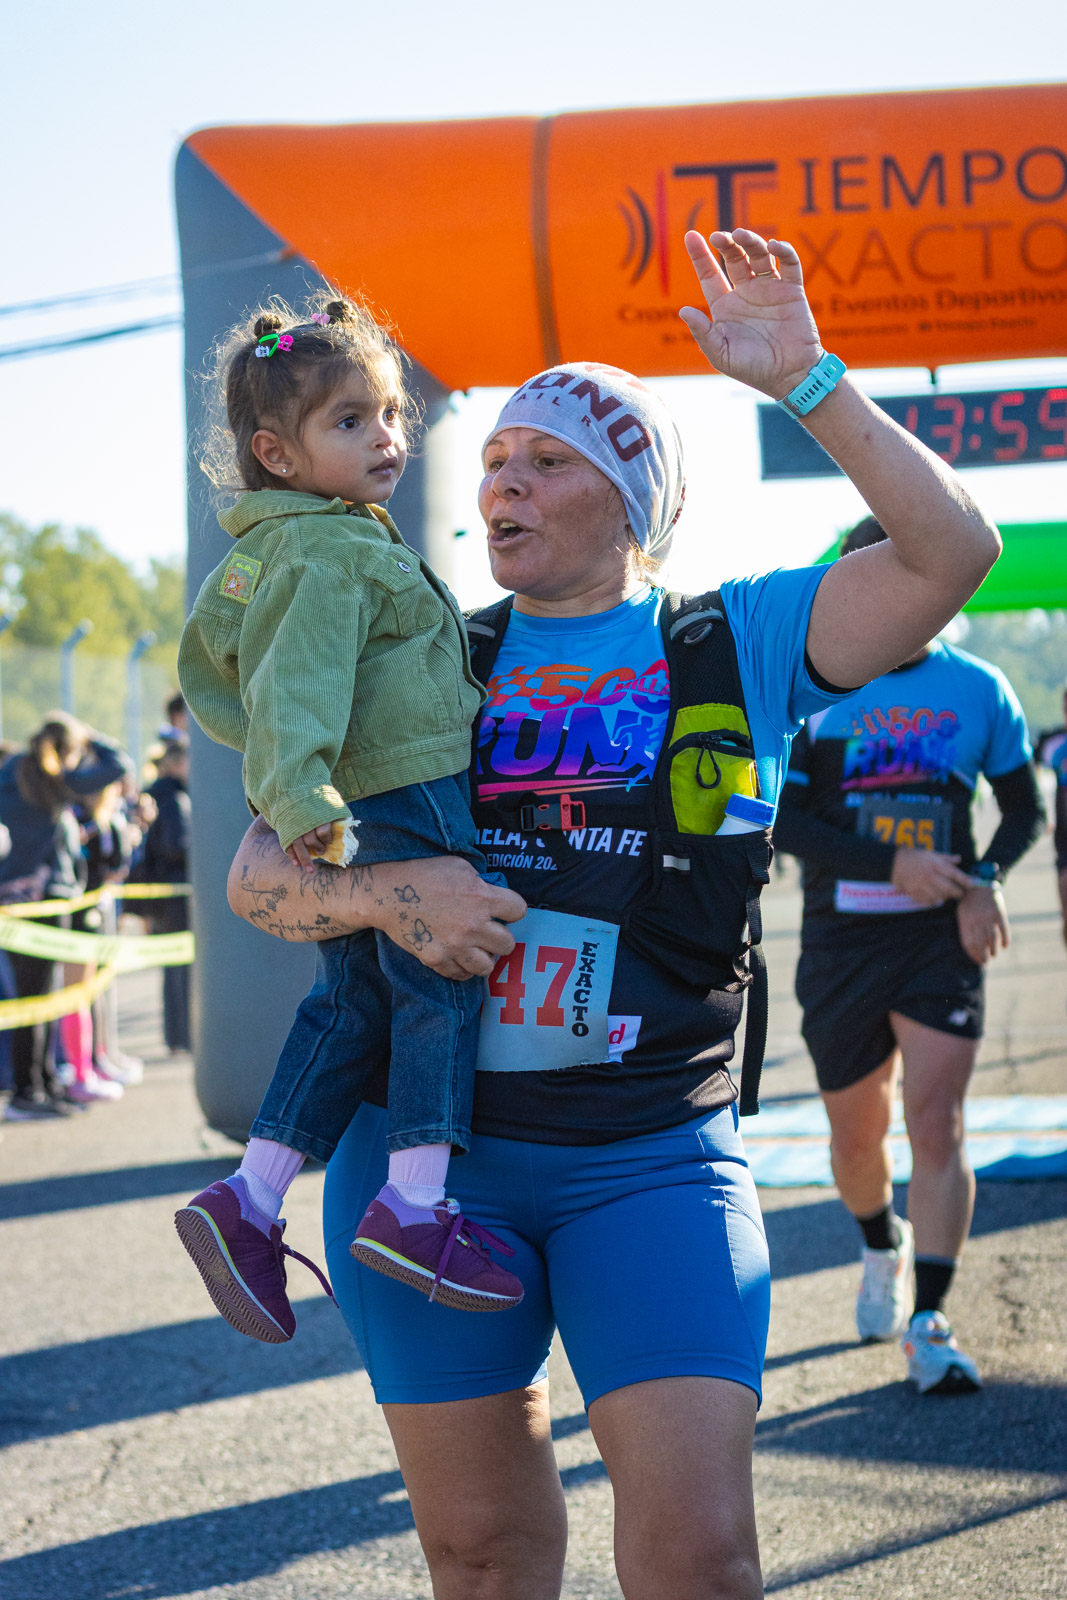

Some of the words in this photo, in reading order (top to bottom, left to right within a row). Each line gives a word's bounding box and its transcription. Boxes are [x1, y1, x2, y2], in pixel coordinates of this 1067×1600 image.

[831, 292, 929, 316] Eventos
[937, 286, 1067, 311] Deportivo
[616, 829, 648, 857] FE
[487, 851, 534, 868] EDICIÓN
[488, 942, 578, 1028] 47
[571, 941, 600, 1037] EXACTO
